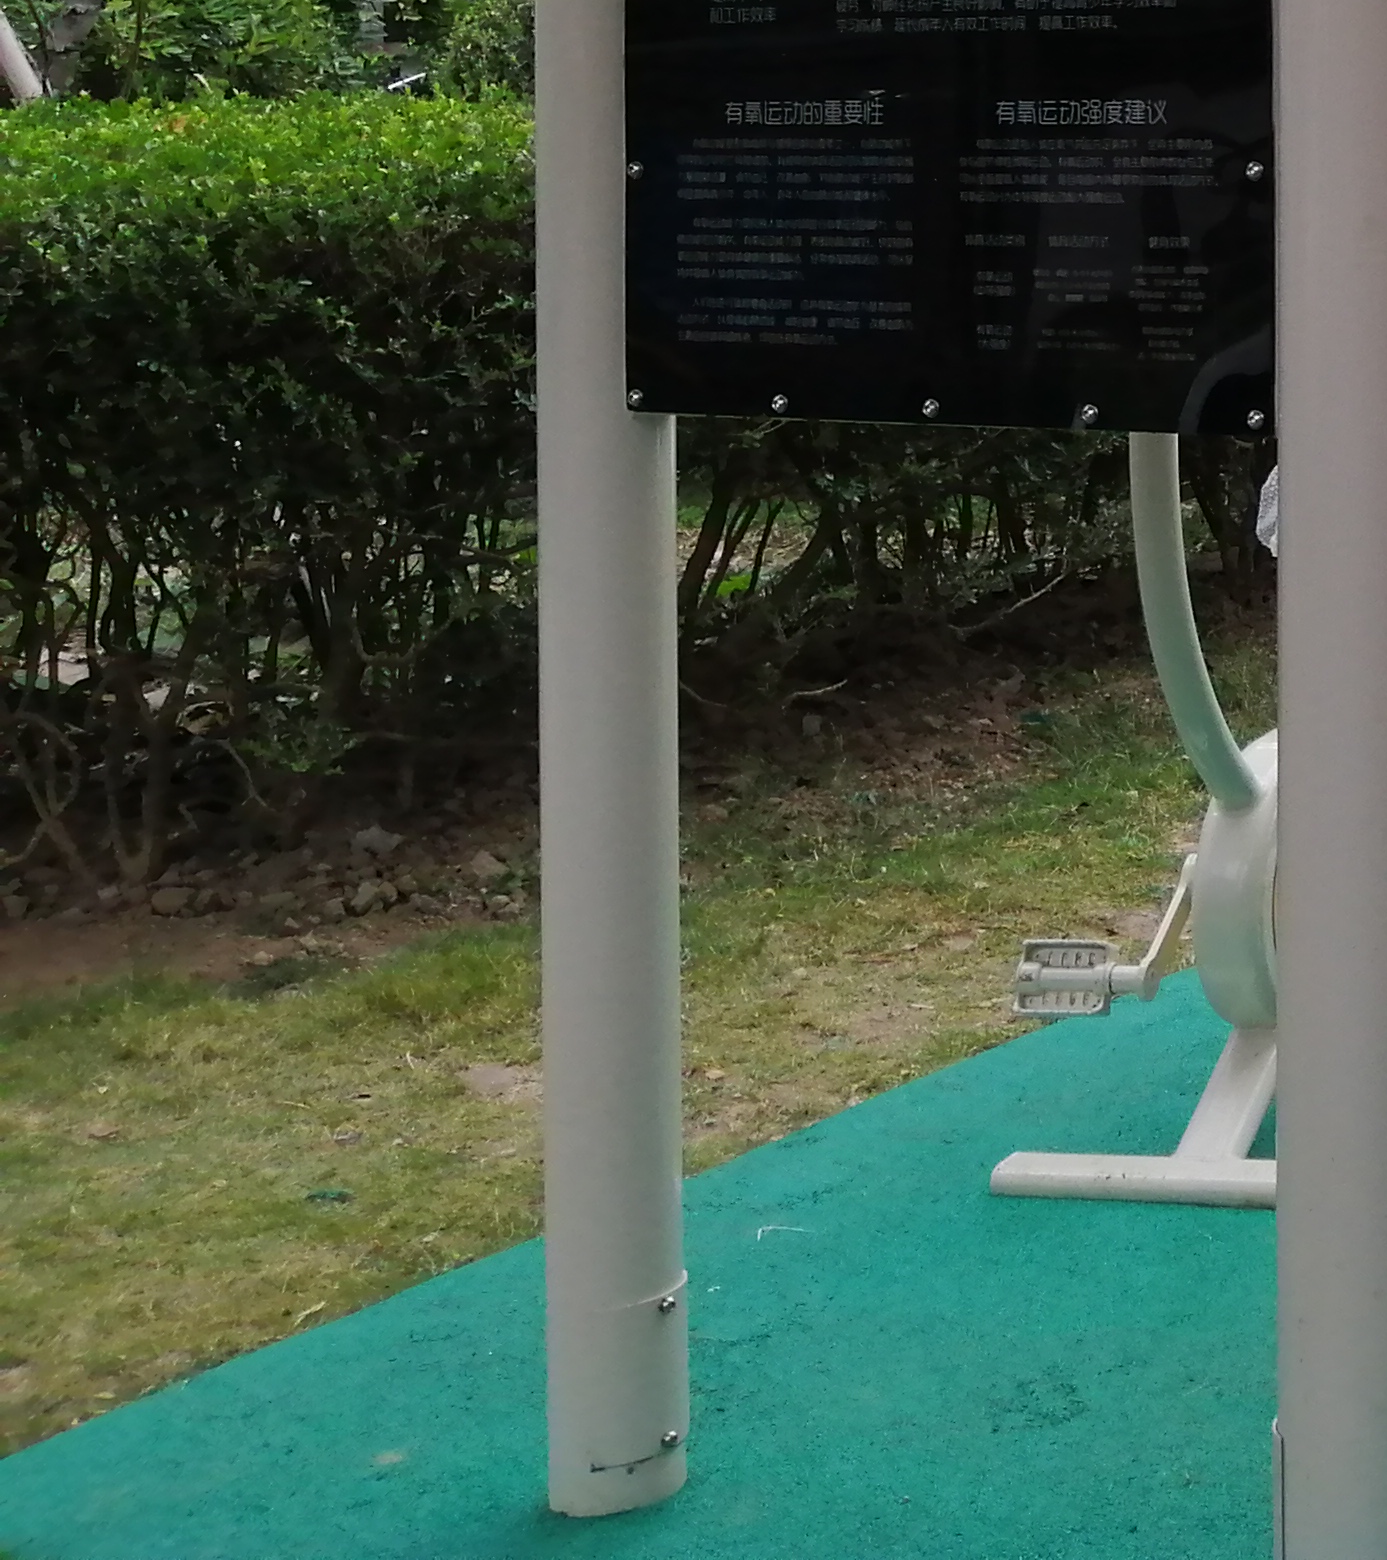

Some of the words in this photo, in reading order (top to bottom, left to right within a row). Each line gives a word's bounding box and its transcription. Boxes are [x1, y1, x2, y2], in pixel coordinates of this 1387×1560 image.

[725, 100, 885, 126] 有氧运动的重要性
[996, 100, 1168, 126] 有氧运动强度建议
